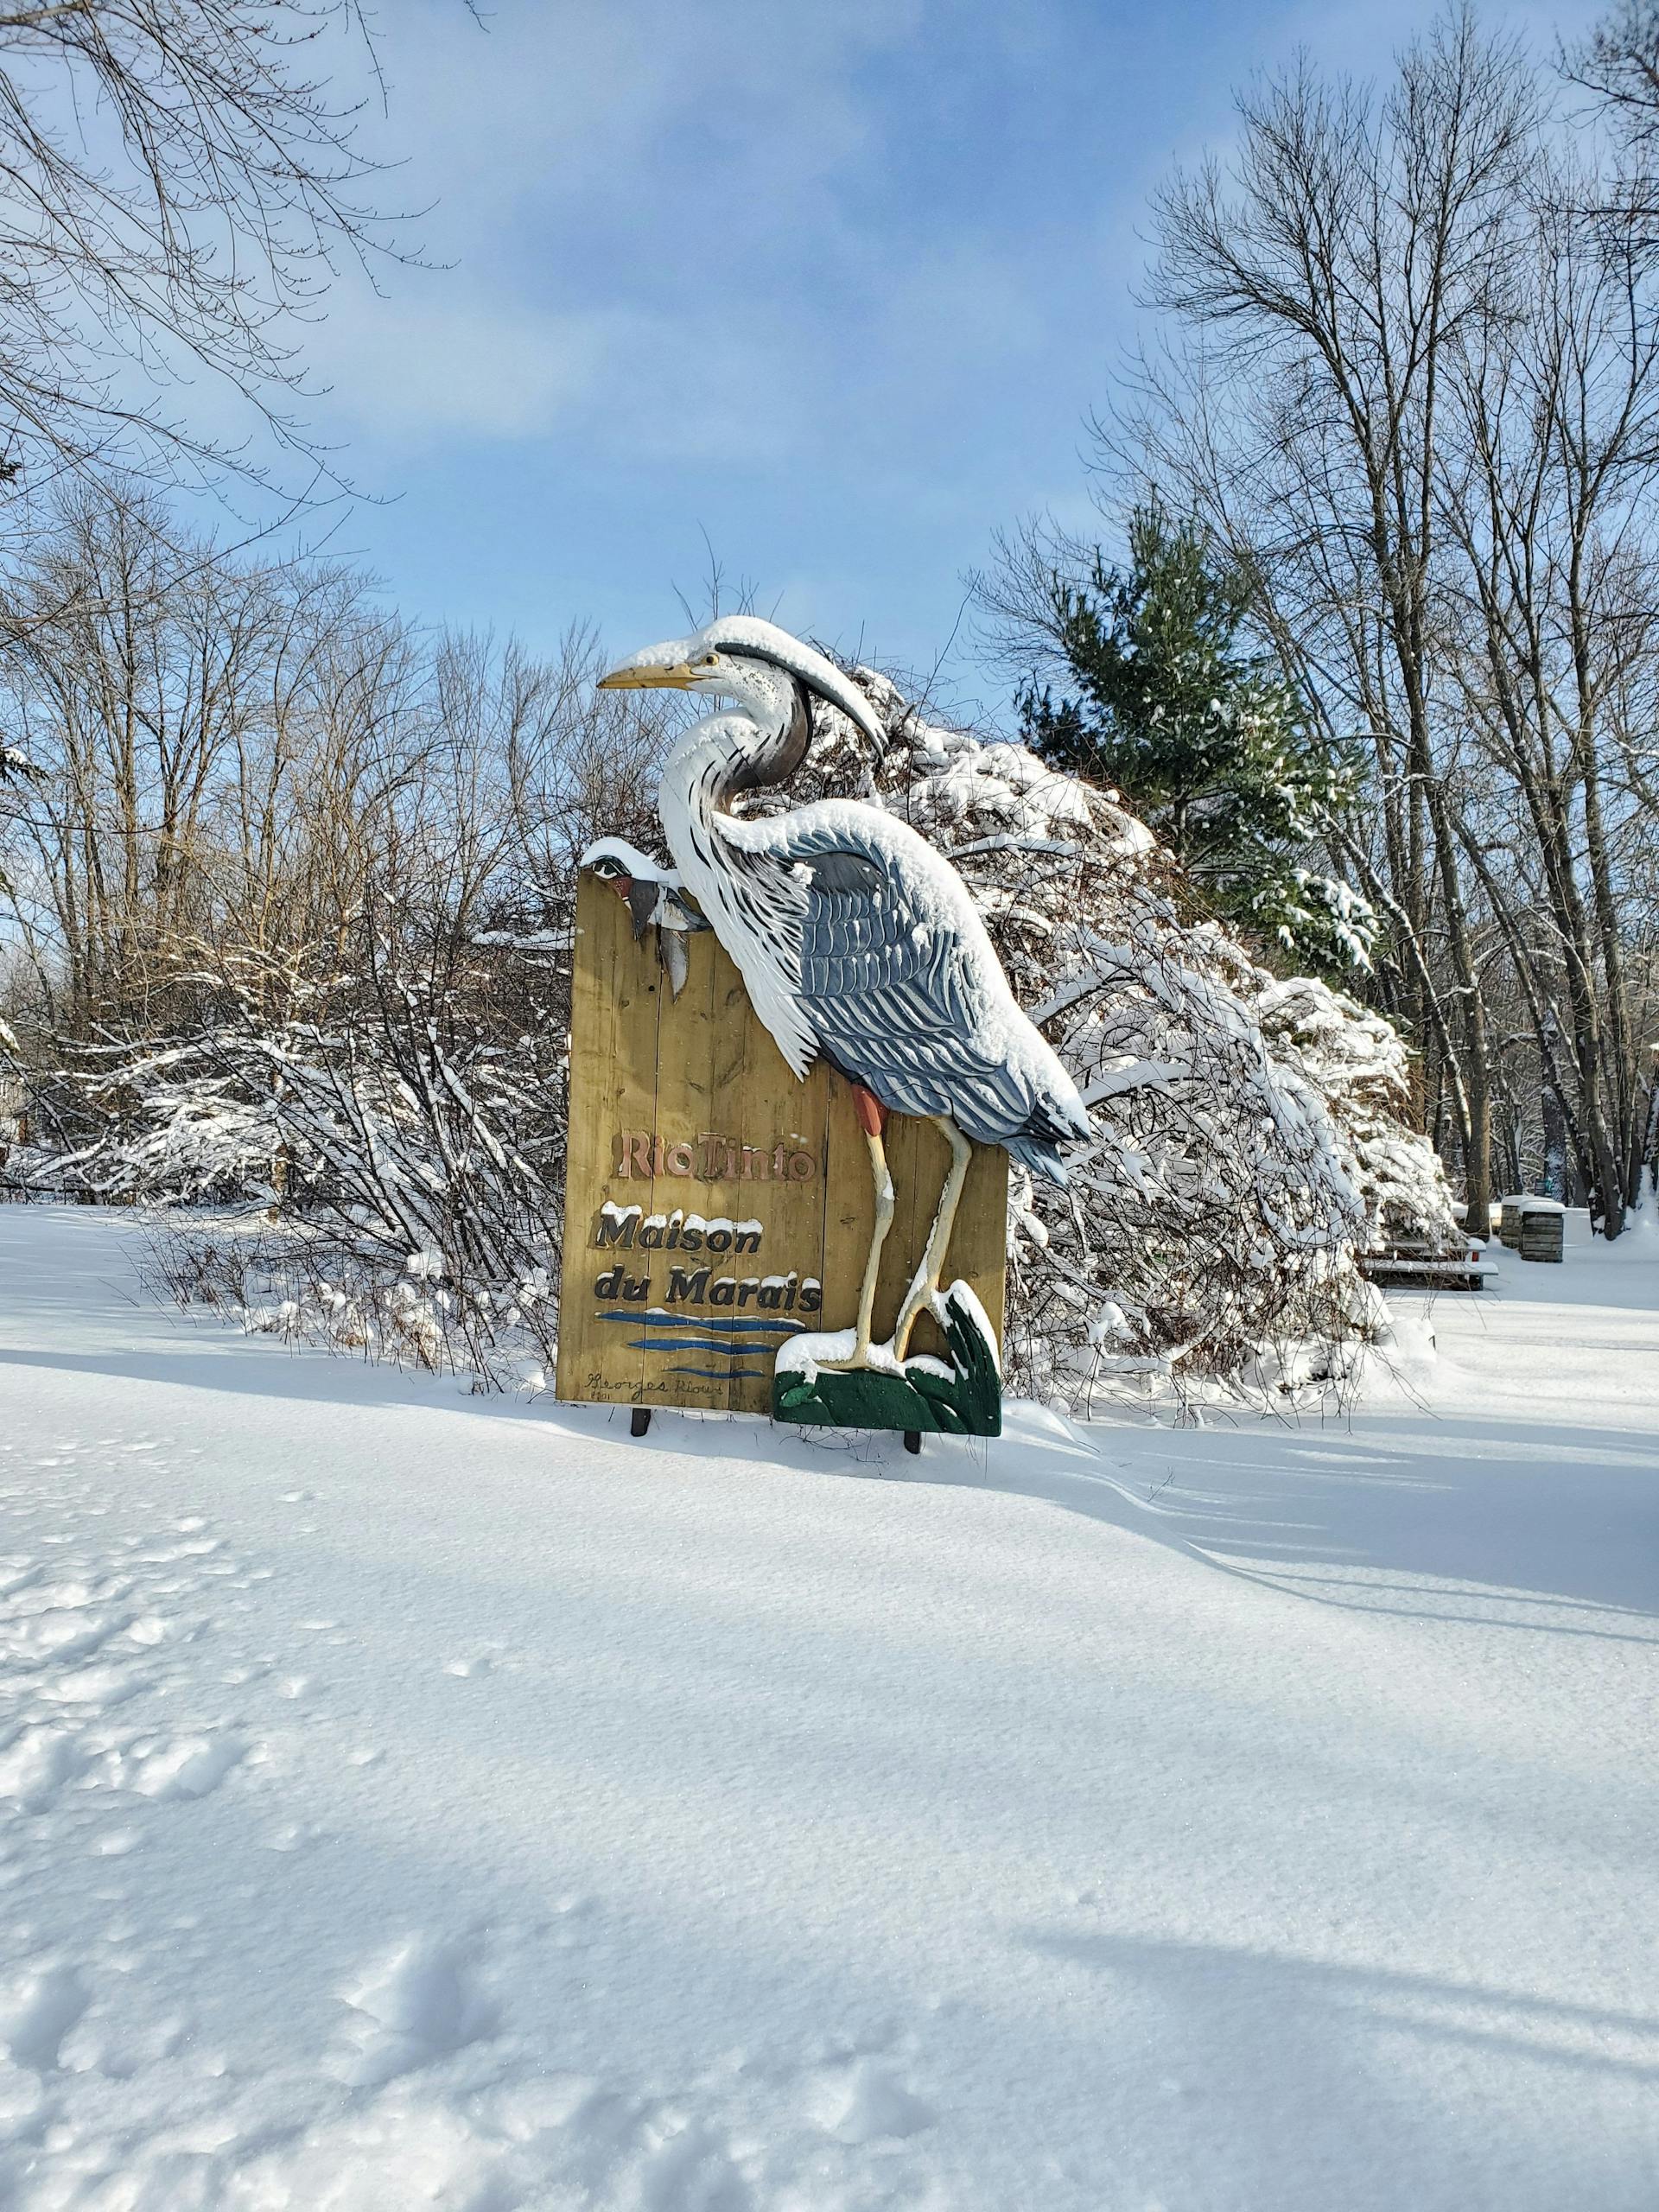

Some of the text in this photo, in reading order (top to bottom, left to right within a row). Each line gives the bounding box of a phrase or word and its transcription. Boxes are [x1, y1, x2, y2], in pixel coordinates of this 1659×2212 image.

[594, 1207, 763, 1253] Maison
[594, 1264, 822, 1312] du Marais
[584, 1373, 669, 1401] Georges
